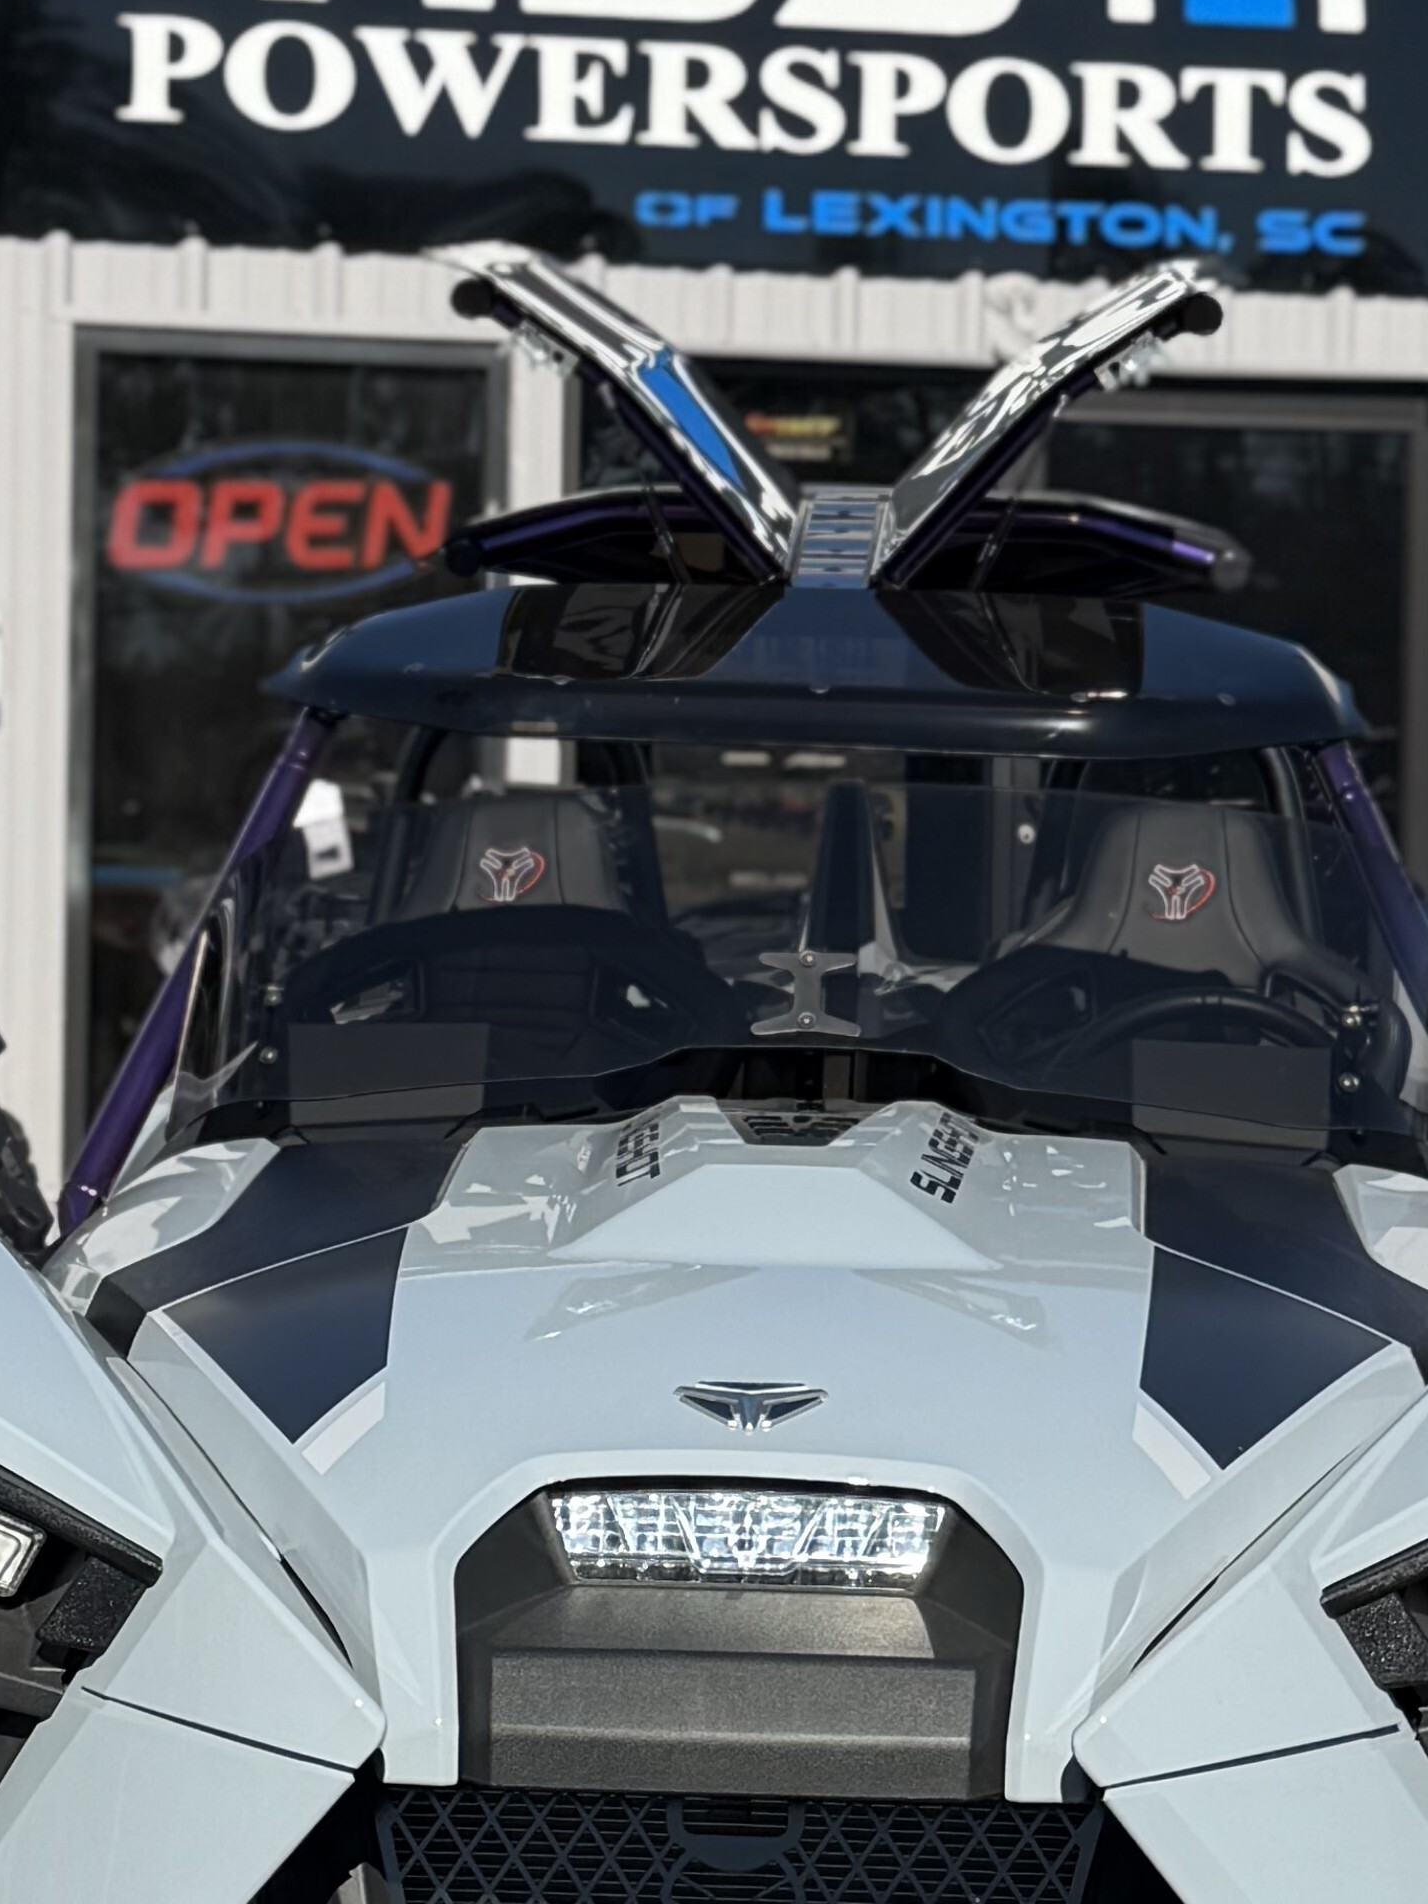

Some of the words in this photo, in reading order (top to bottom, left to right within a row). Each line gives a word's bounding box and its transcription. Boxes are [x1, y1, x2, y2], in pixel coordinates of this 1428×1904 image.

[117, 13, 1372, 177] POWERSPORTS
[634, 190, 738, 229] OF
[760, 187, 1234, 253] LEXINGTON,
[1254, 207, 1364, 256] SC
[107, 478, 452, 570] OPEN
